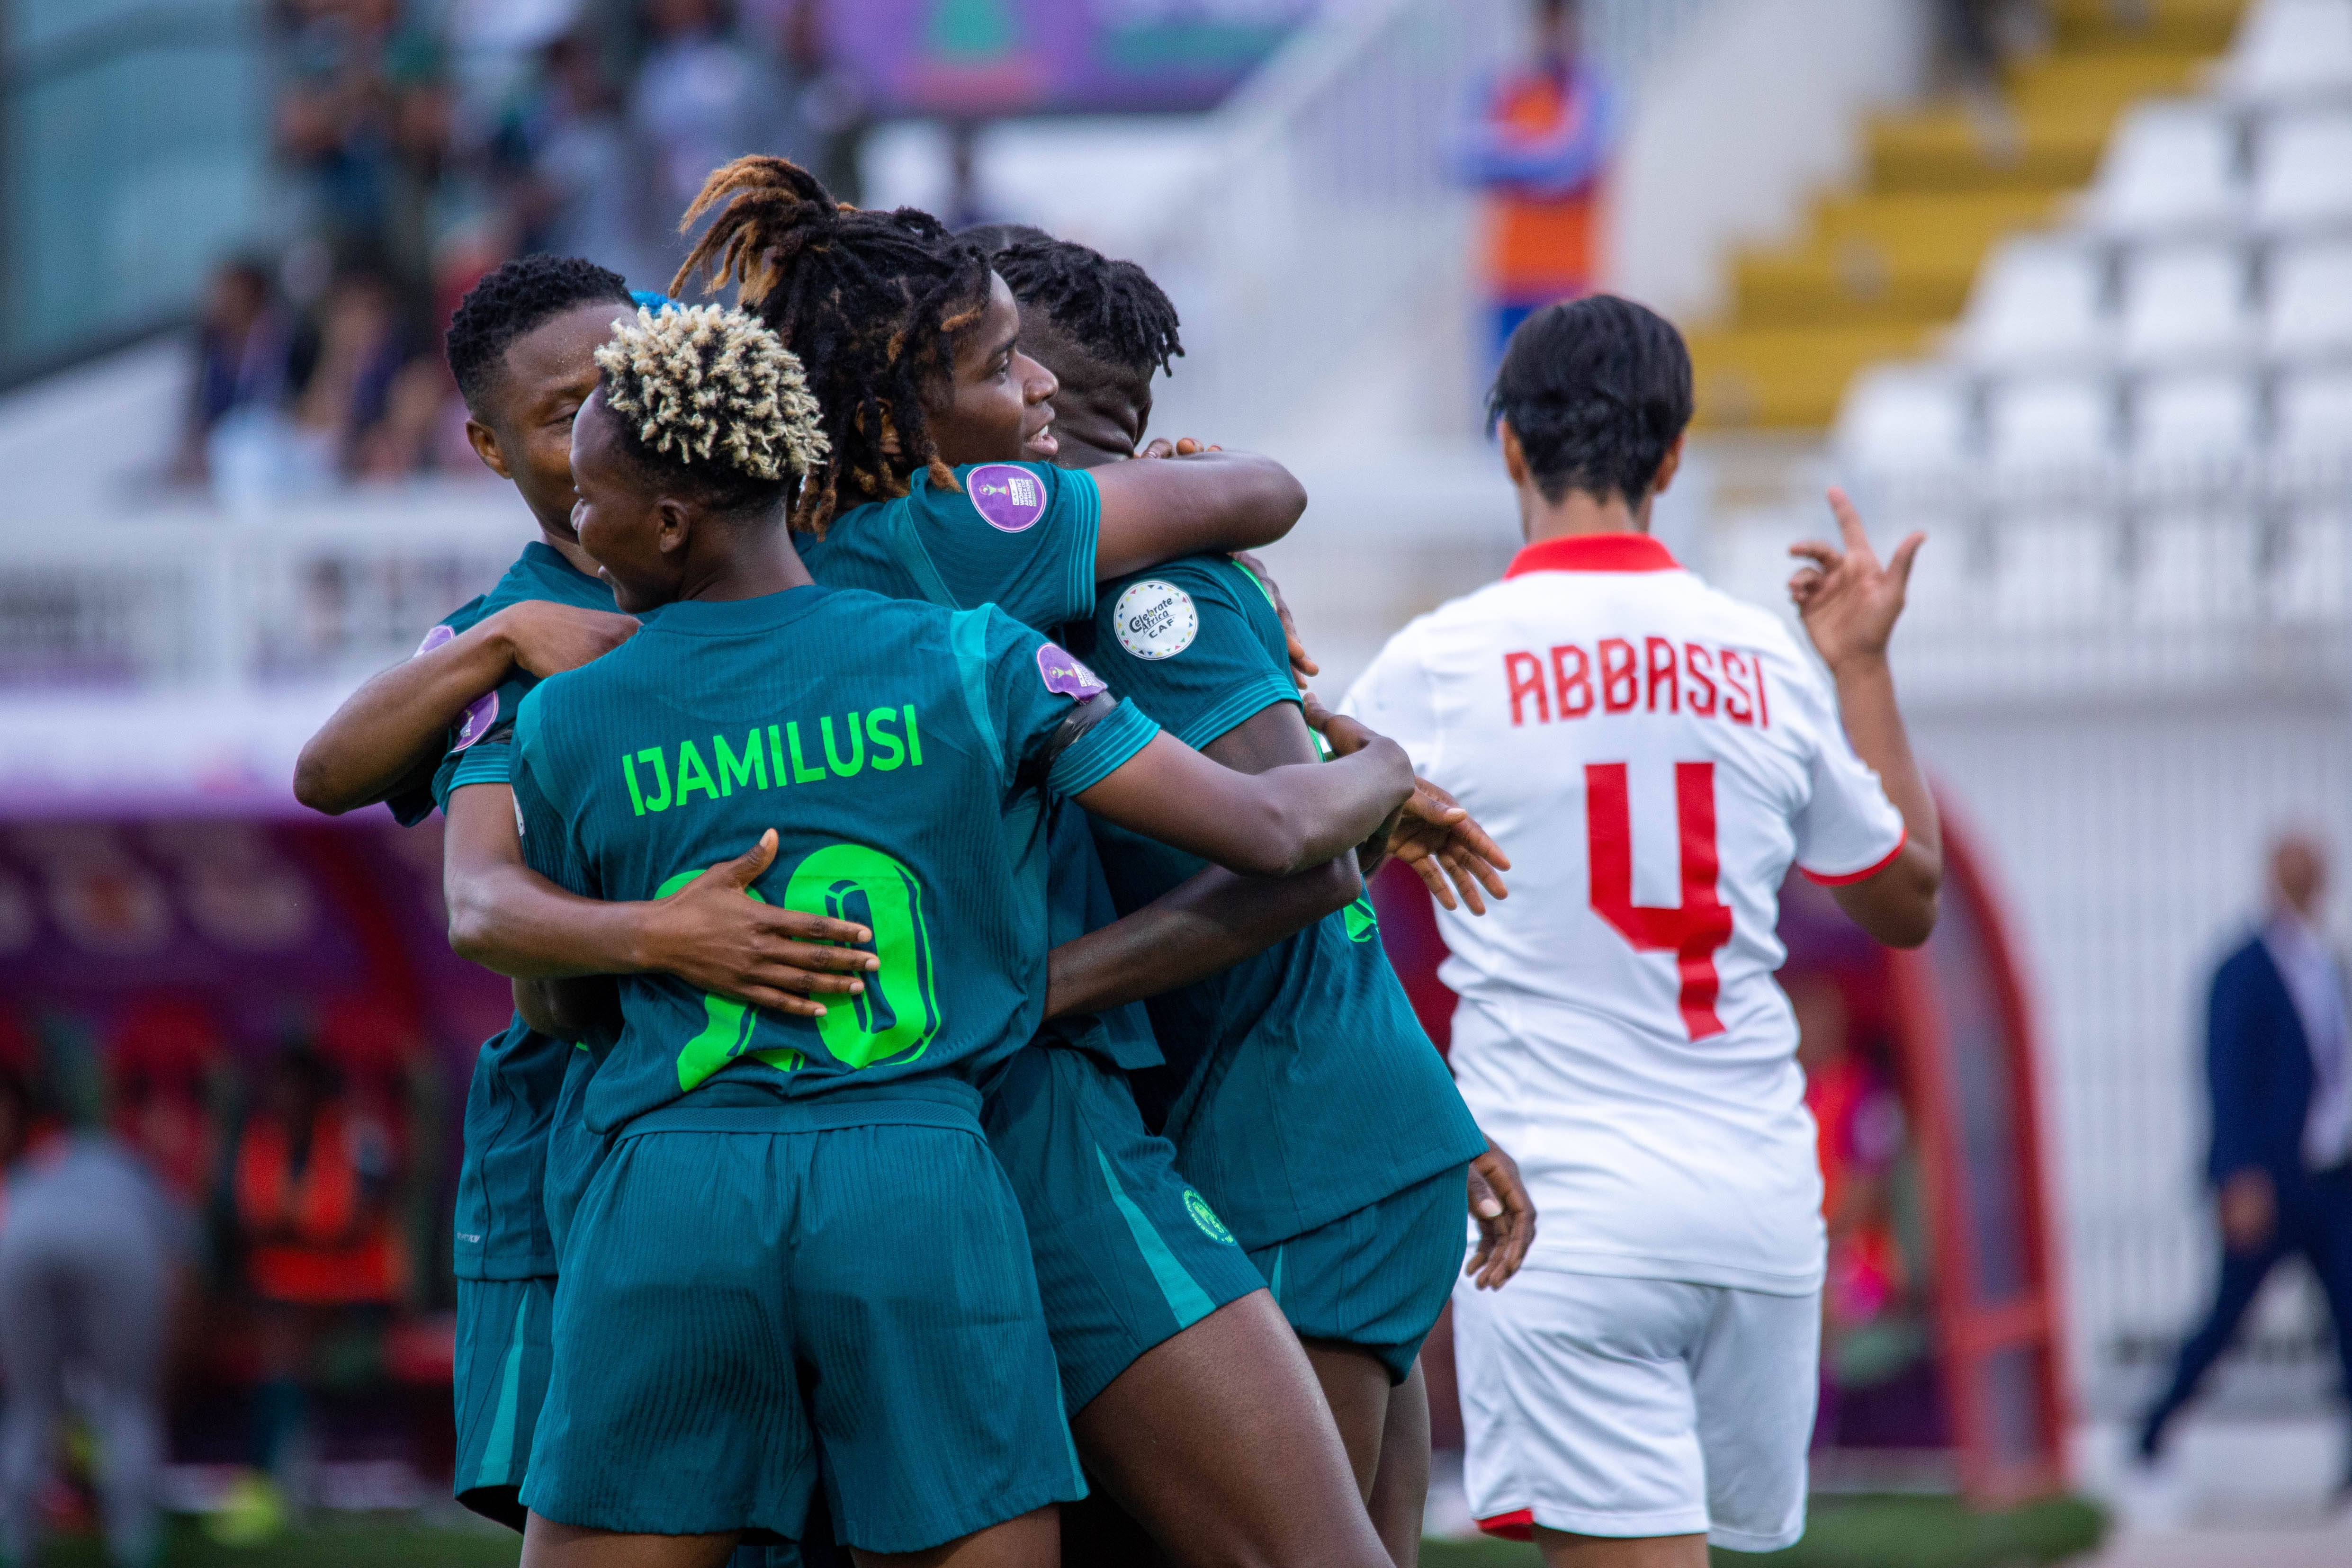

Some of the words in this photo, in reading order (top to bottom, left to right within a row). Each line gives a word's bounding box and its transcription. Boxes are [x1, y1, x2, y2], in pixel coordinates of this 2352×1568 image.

[1015, 479, 1024, 505] WOMEN'S
[1129, 598, 1173, 633] Celebrate
[1142, 610, 1169, 634] Africa
[1149, 618, 1174, 639] CAF
[1504, 636, 1769, 729] ABBASSI
[622, 704, 922, 816] IJAMILUSI
[1583, 762, 1733, 1042] 4
